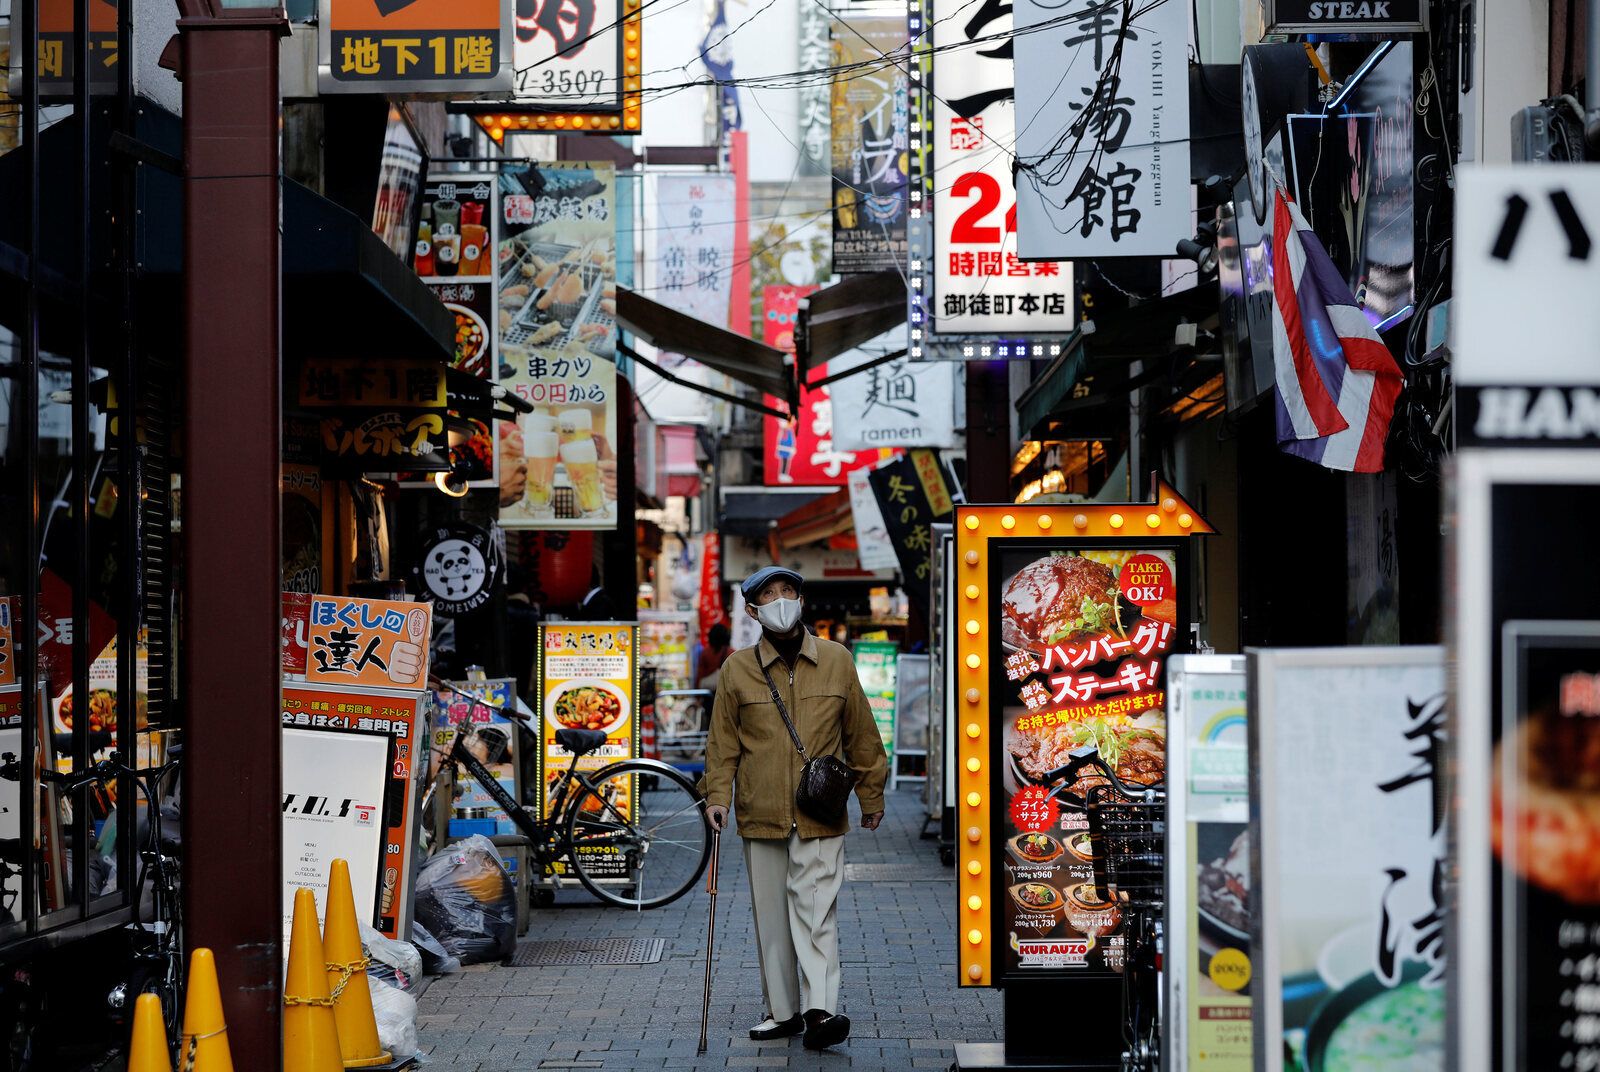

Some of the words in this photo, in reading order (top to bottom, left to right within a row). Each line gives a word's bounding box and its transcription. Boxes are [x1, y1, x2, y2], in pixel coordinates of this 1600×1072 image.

[1308, 1, 1390, 19] STEAK
[341, 36, 494, 75] 地下1階
[1151, 40, 1163, 97] YOKIHI
[950, 172, 1019, 244] 2
[1490, 189, 1592, 261] ハ
[949, 252, 1059, 277] 時間営業
[944, 293, 1065, 316] 御徒町本店
[528, 356, 592, 380] 串カツ
[515, 384, 605, 404] 50円から
[861, 425, 922, 442] ramen
[1128, 563, 1164, 573] TAKE
[1130, 574, 1161, 585] OUT
[1126, 587, 1165, 601] OK!
[312, 601, 406, 634] ほぐしの
[313, 626, 388, 677] 達人
[1042, 622, 1171, 670] ハンバーグ!
[1007, 650, 1031, 667] 肉汁
[1006, 661, 1040, 681] 溢れる
[1021, 681, 1045, 698] 炭火
[1051, 661, 1159, 704] ステーキ!
[1025, 693, 1048, 710] 焼き
[1017, 692, 1165, 731] お持ち帰りいただけます!
[435, 731, 454, 745] 3F
[1024, 790, 1044, 799] 全品
[387, 844, 400, 854] 80
[1033, 871, 1053, 879] ¥960
[1030, 919, 1056, 928] ¥1,730
[1086, 919, 1113, 928] ¥1,840
[1019, 944, 1087, 954] KURAUZO
